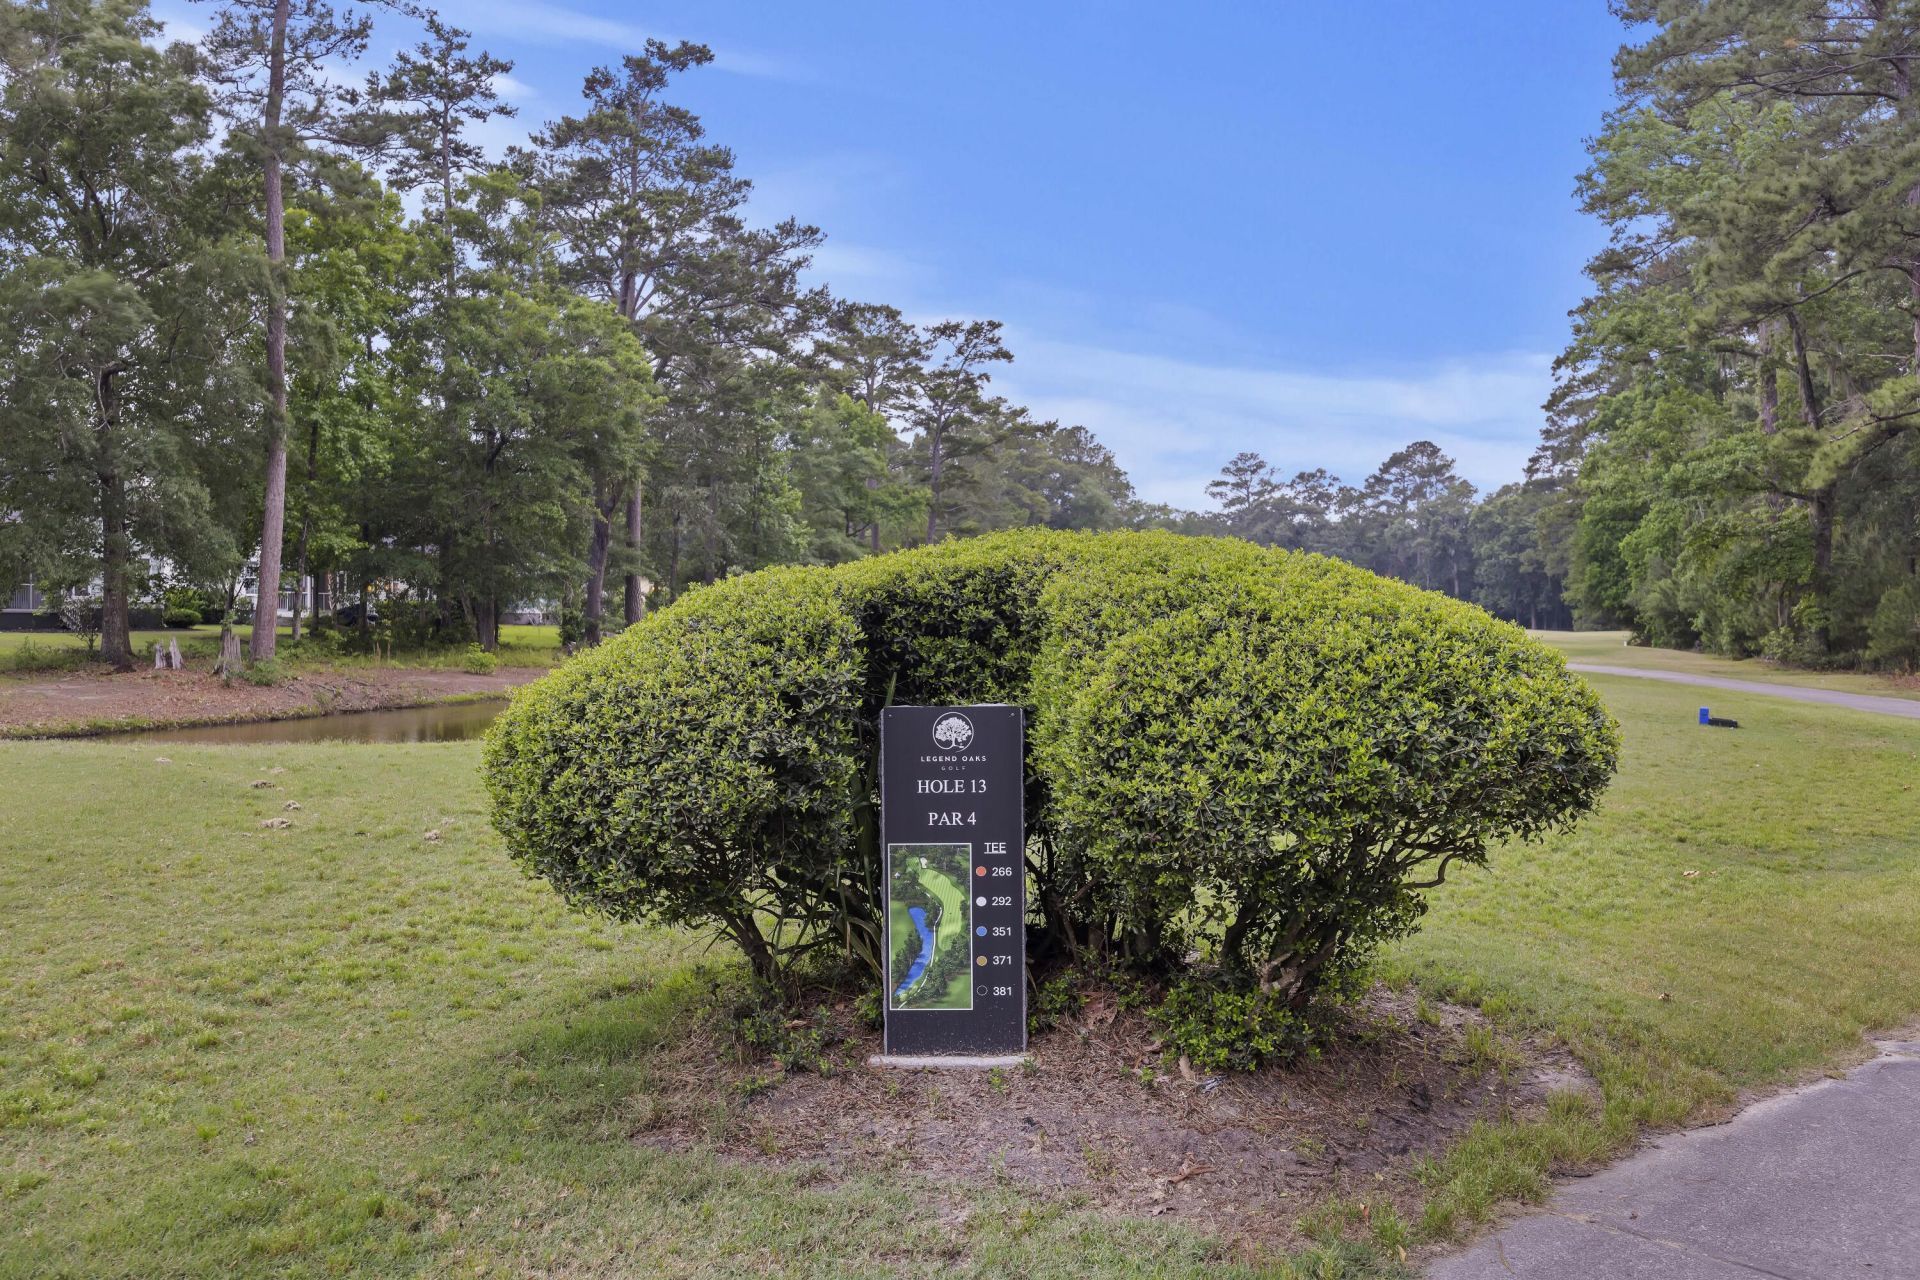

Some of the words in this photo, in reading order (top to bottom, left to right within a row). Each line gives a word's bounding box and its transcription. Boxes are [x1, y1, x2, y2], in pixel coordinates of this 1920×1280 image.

[917, 779, 966, 794] HOLE
[970, 779, 987, 793] 13
[928, 812, 964, 826] PAR
[967, 812, 977, 825] 4
[984, 842, 1007, 853] TEE
[991, 866, 1012, 877] 266
[991, 896, 1012, 906] 292
[992, 926, 1012, 937] 351
[992, 955, 1012, 965] 371
[992, 986, 1012, 996] 381
